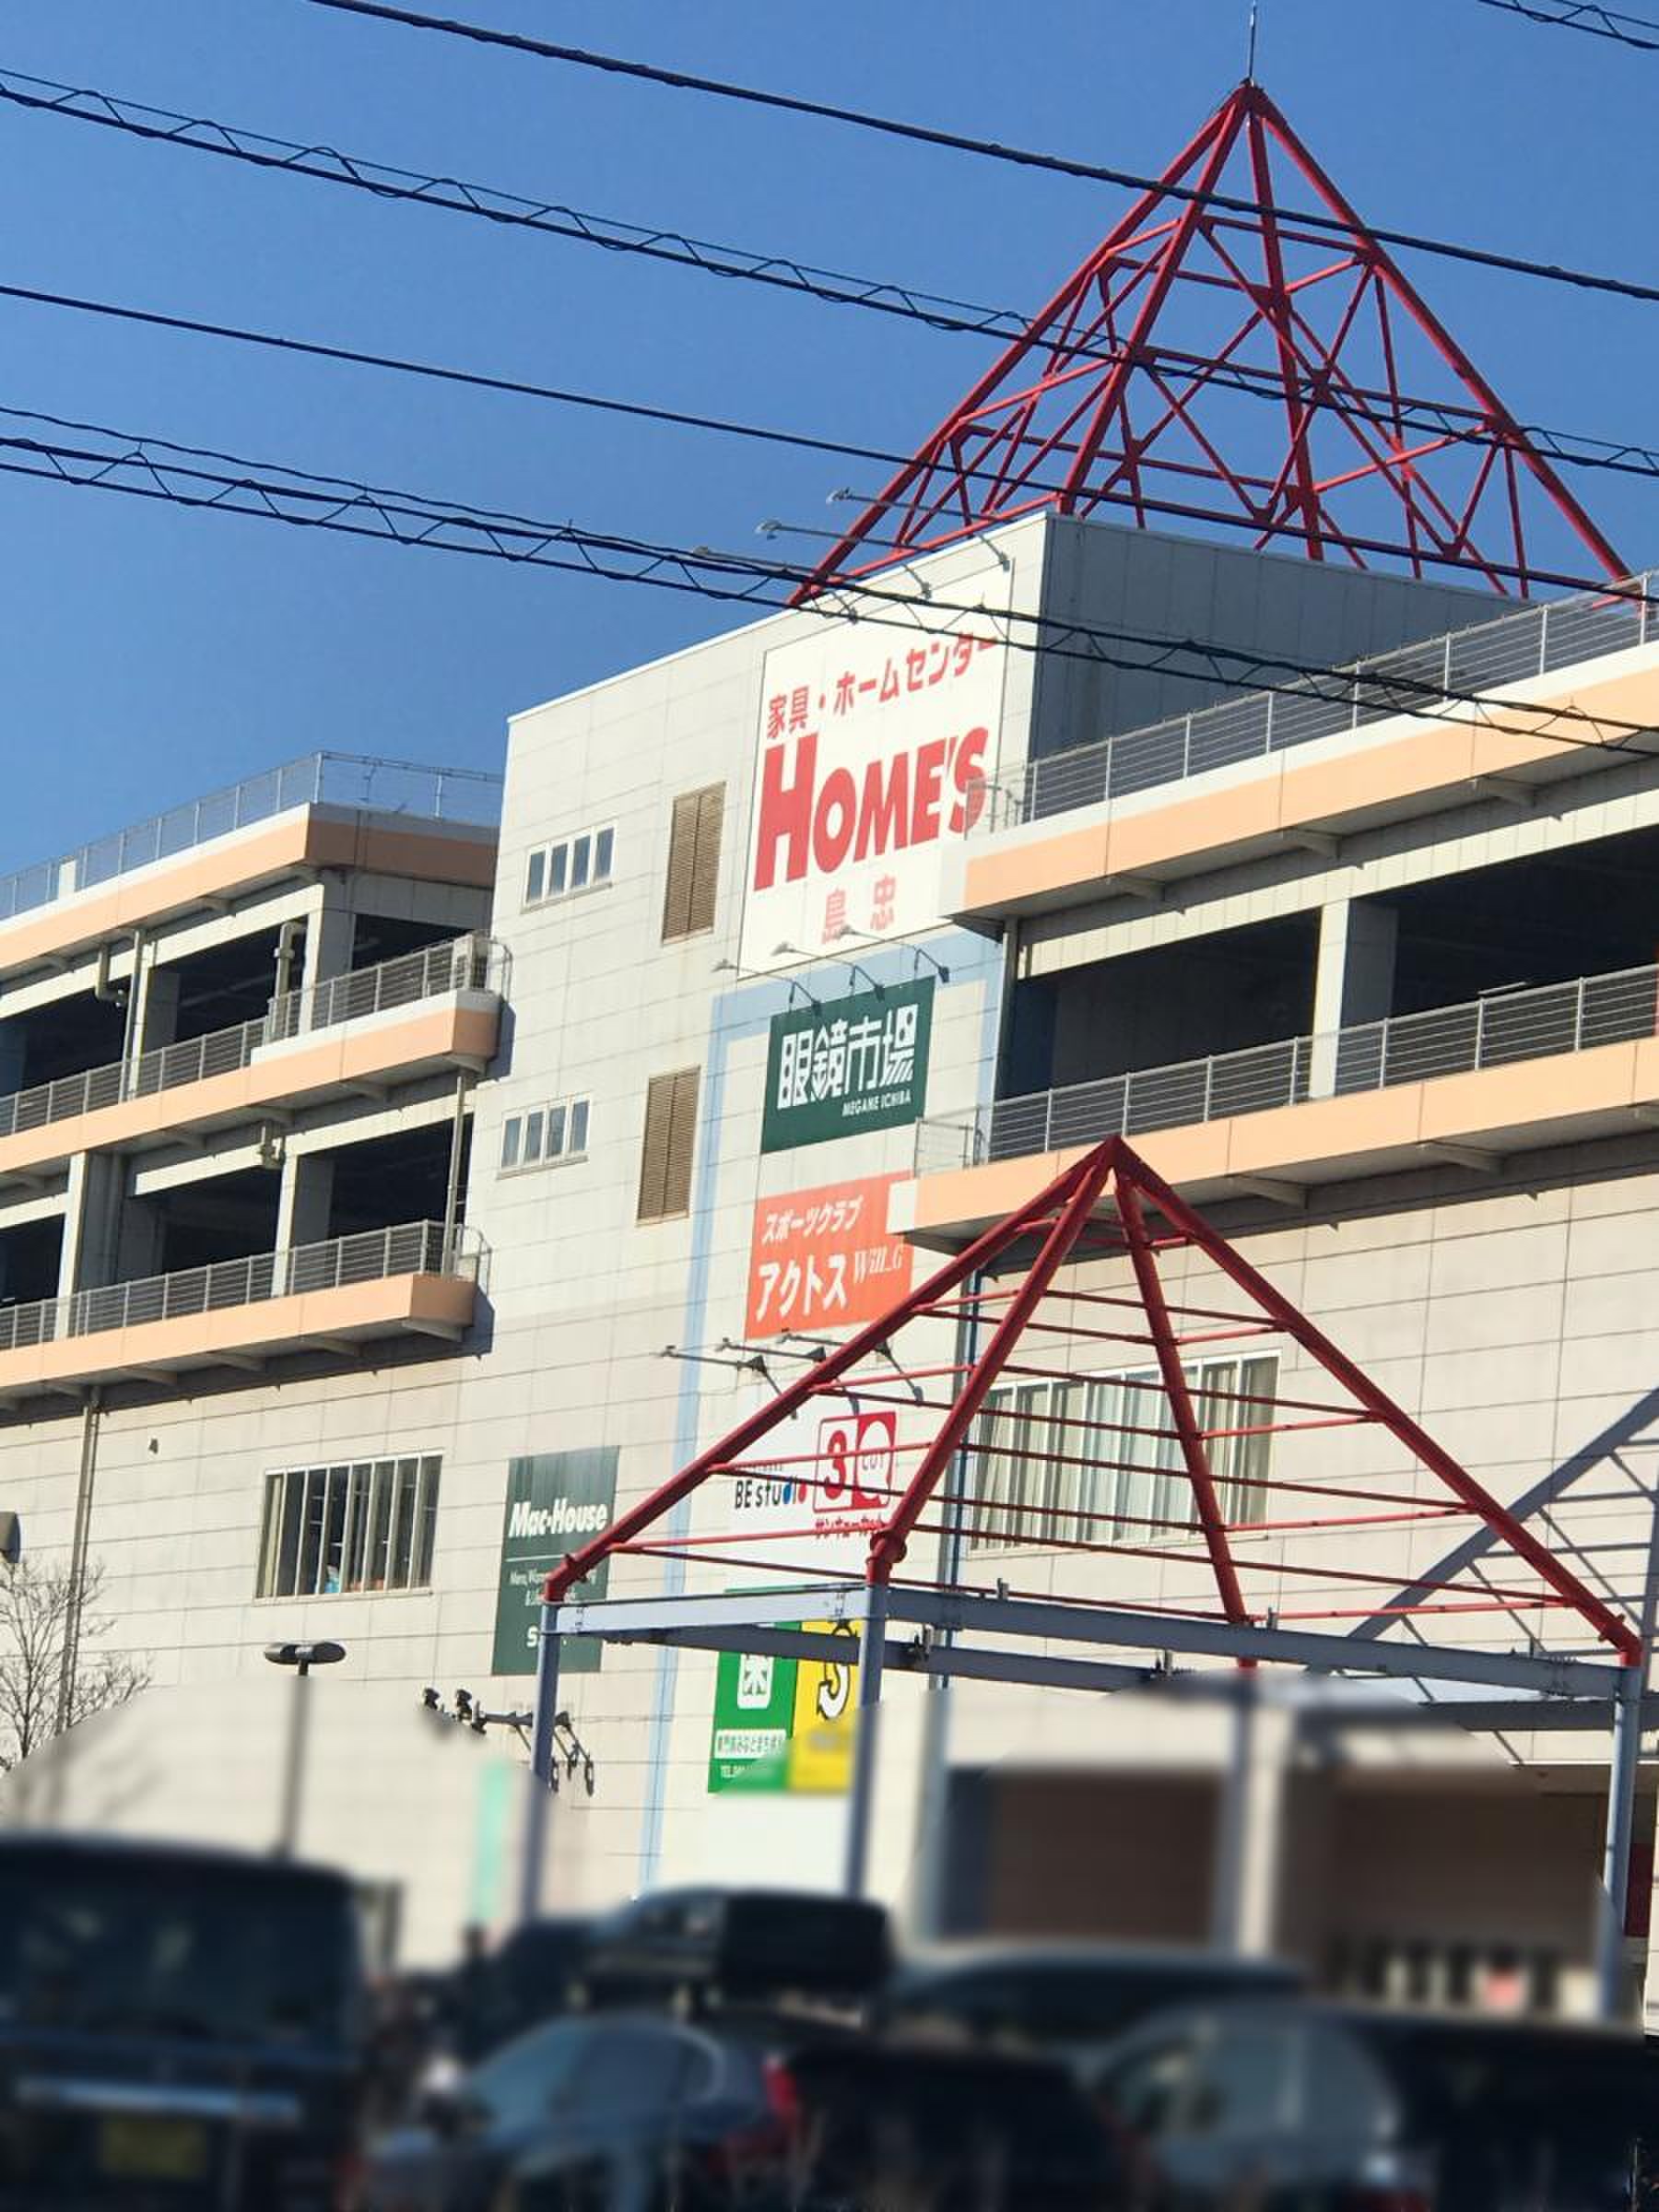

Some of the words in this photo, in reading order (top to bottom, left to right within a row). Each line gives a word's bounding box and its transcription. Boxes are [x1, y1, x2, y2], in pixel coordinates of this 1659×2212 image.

[753, 726, 989, 891] HOME'S
[820, 874, 896, 944] 島忠
[777, 1004, 919, 1109] 眼鏡市場
[841, 1096, 879, 1117] MEGANE
[880, 1089, 912, 1109] ICHIBA
[761, 1194, 864, 1245] スポーツクラブ
[756, 1253, 847, 1322] アクトス
